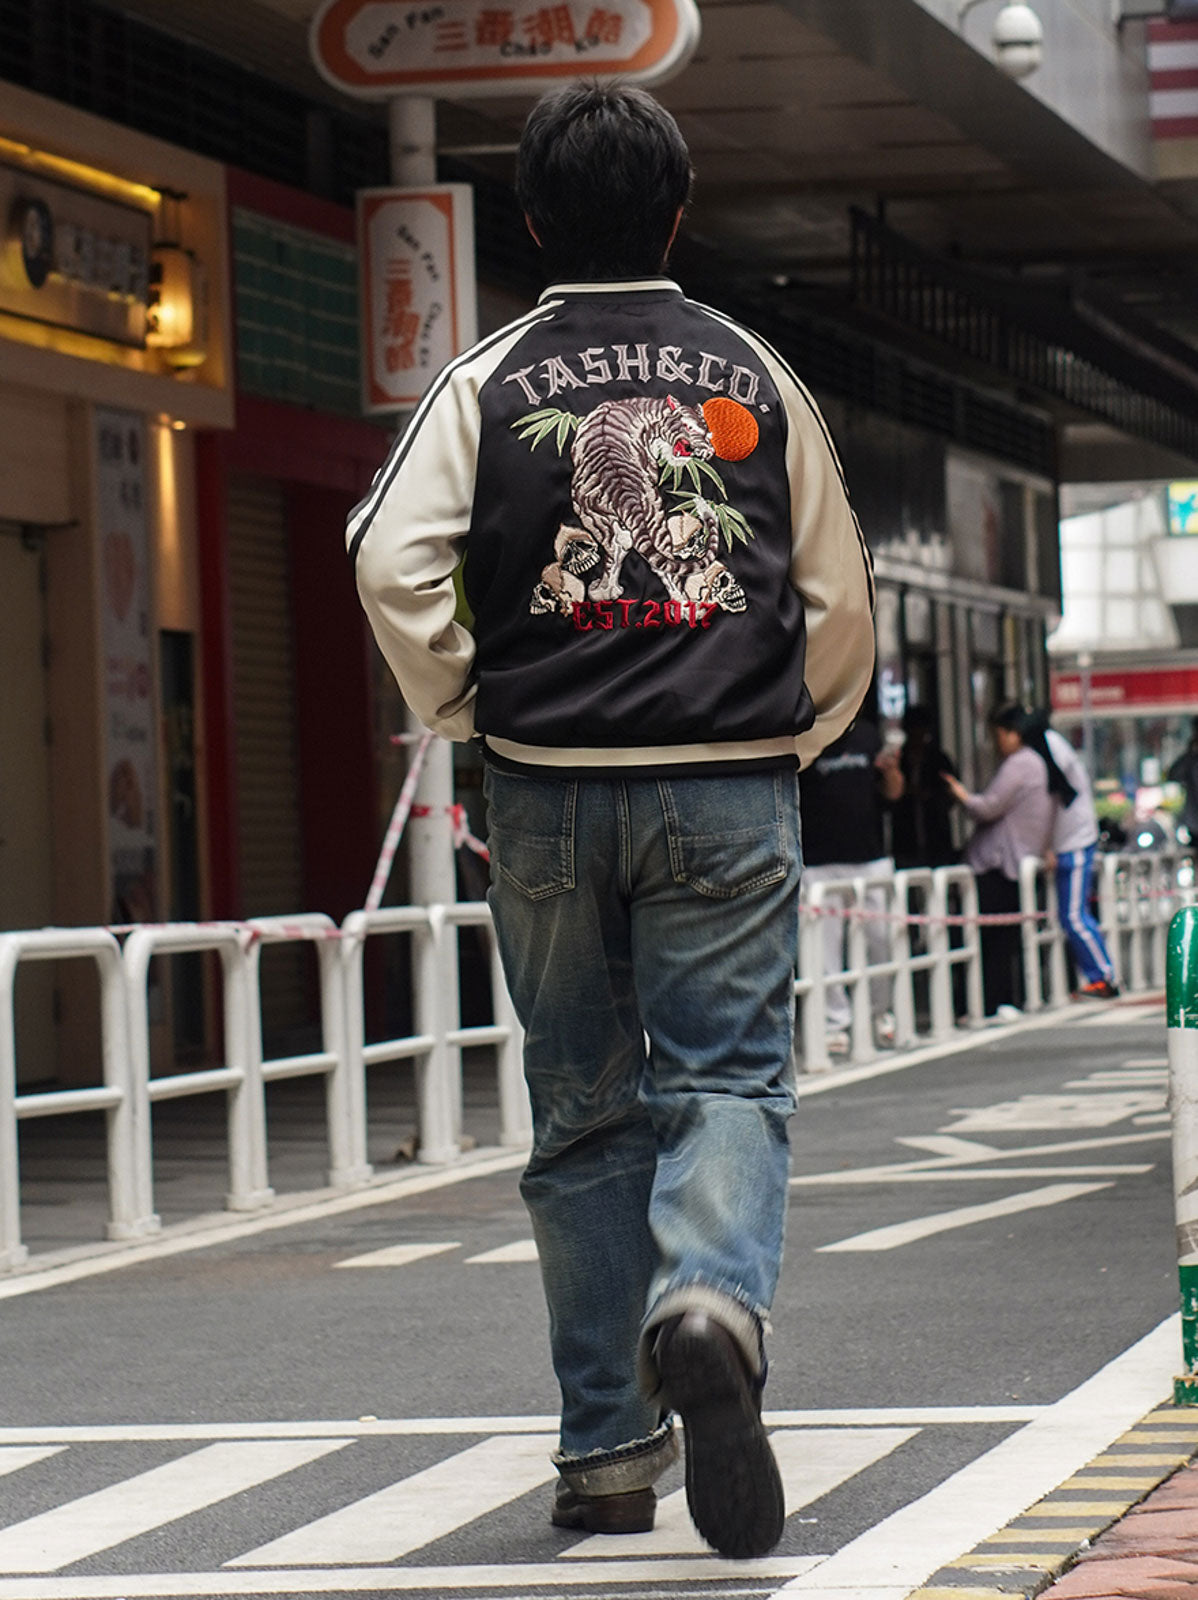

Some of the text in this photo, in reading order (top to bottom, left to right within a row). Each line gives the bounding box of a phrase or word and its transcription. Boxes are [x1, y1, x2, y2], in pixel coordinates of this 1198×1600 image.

[367, 23, 400, 60] San
[404, 6, 445, 30] Fan
[500, 38, 552, 58] Chao
[502, 343, 770, 414] TASH&CO.
[570, 598, 721, 631] EST.2017
